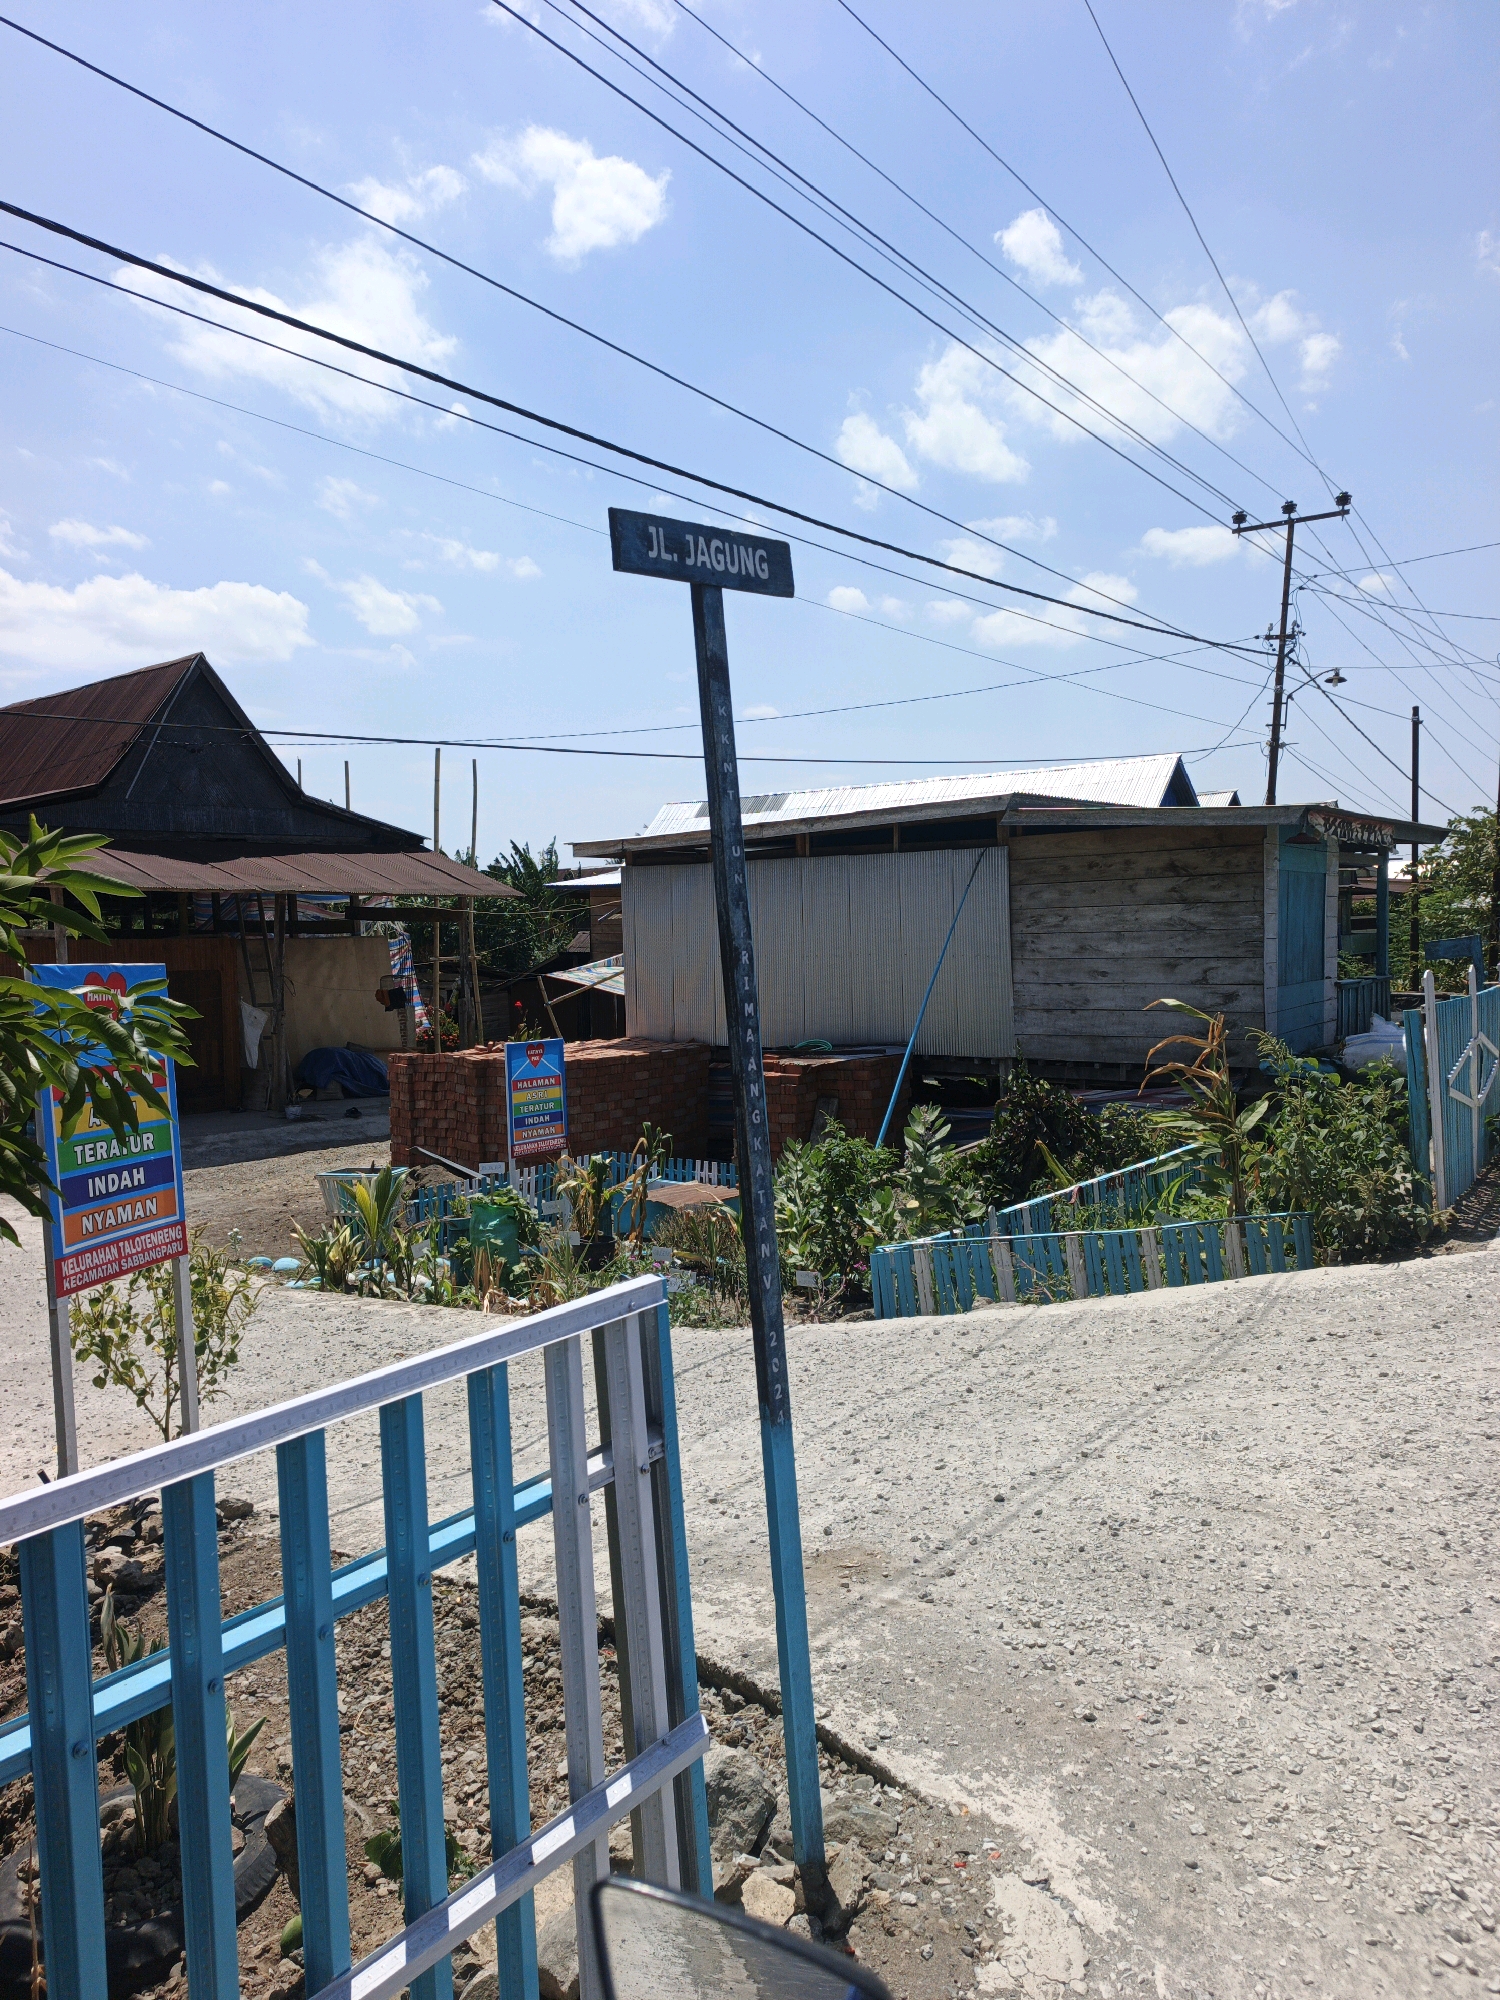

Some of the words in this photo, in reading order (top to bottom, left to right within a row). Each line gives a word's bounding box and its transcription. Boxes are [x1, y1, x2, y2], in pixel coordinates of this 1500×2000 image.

[648, 525, 678, 562] JL.
[685, 534, 769, 580] JAGUNG
[517, 1077, 555, 1089] HALAMAN
[526, 1090, 548, 1100] ASRI
[520, 1102, 555, 1114] TERATUR
[525, 1114, 550, 1126] INDAH
[522, 1126, 555, 1139] NYAMAN
[87, 1166, 146, 1198] INDAH
[81, 1197, 157, 1236] NYAMAN
[61, 1243, 119, 1278] KELURAHAN
[119, 1225, 183, 1257] TALOTENRENG
[63, 1262, 119, 1291] KECAMATAN
[121, 1240, 183, 1270] SABBANGPARU
